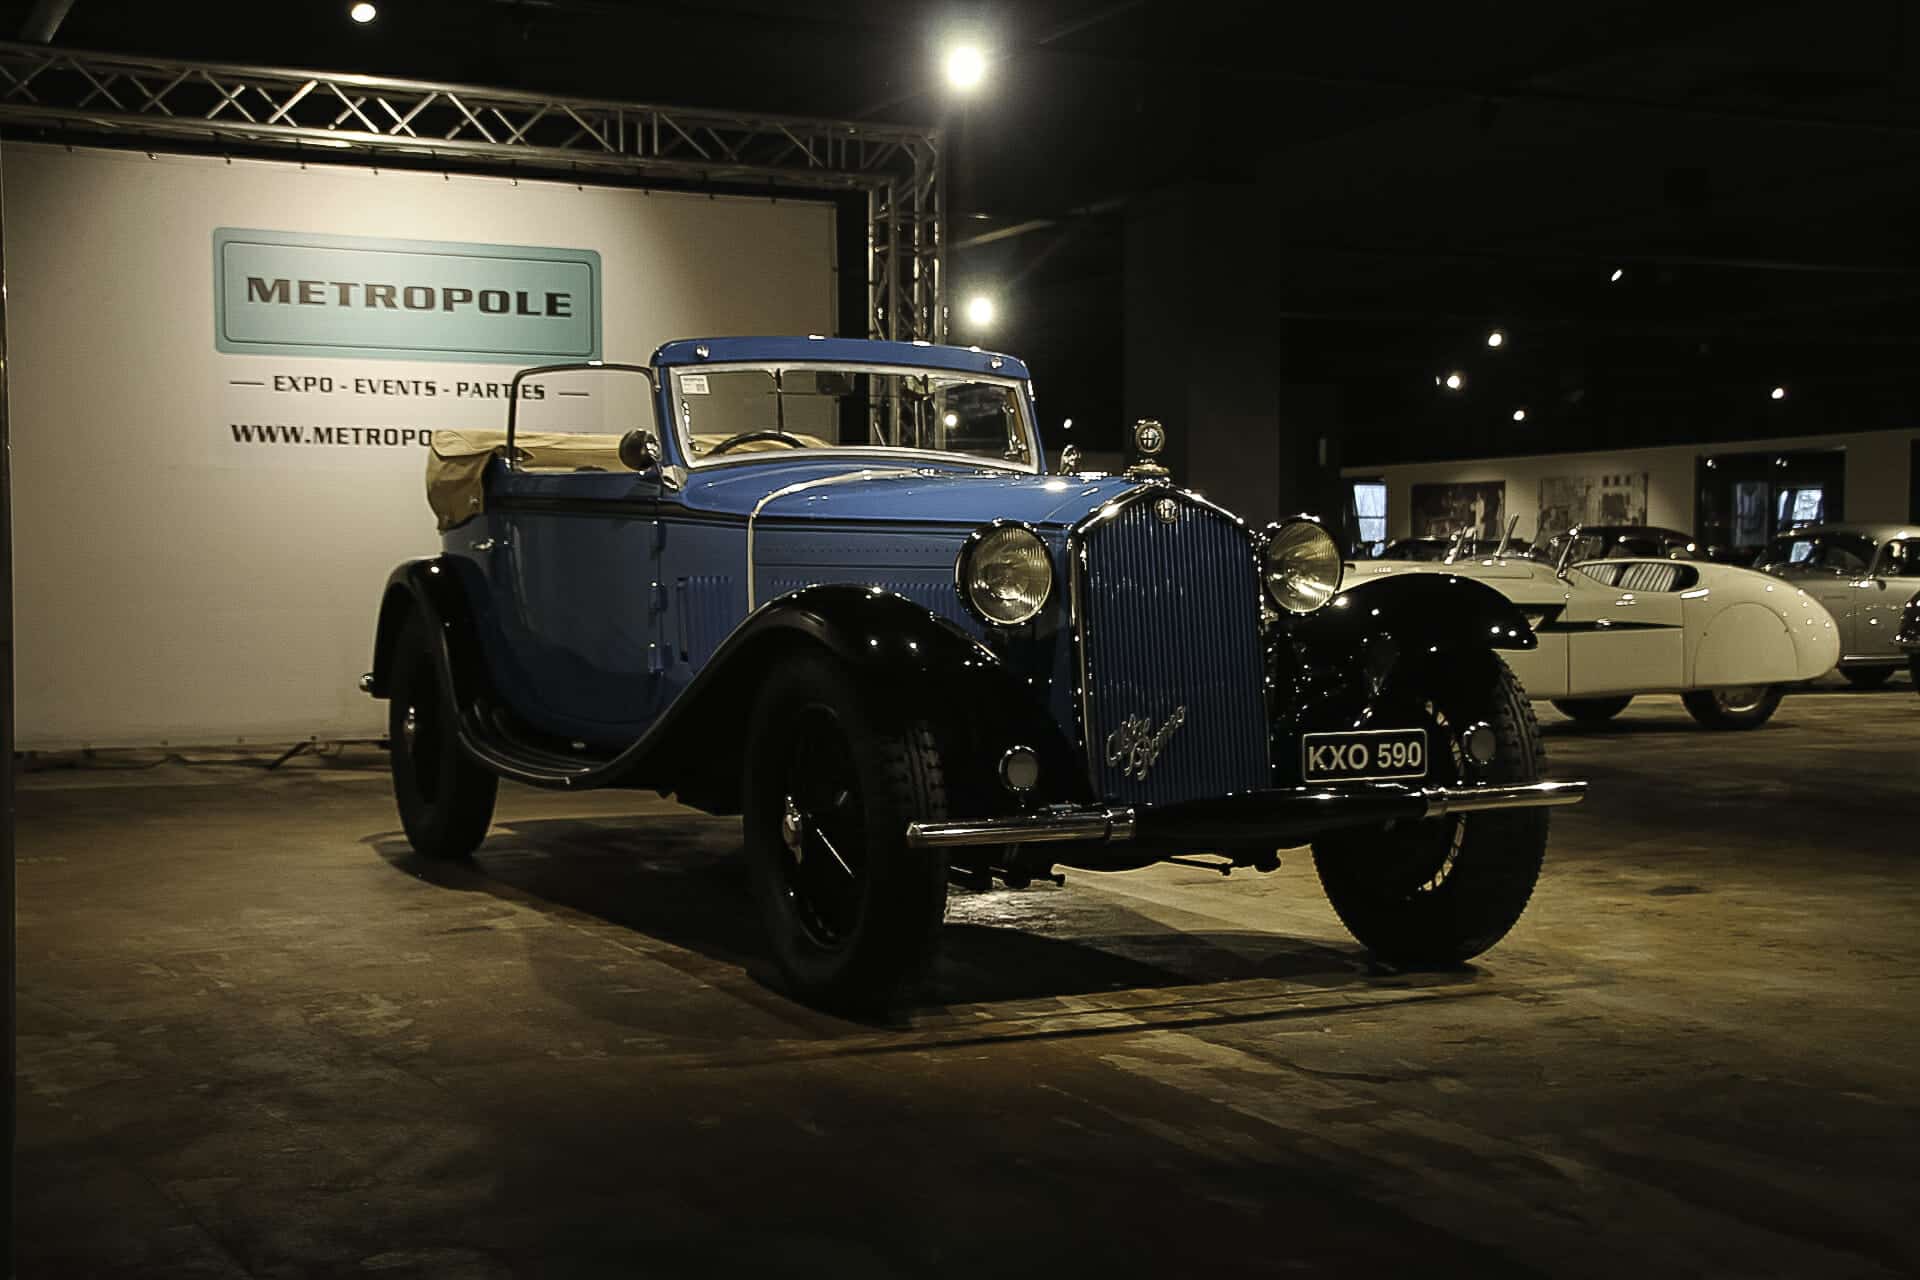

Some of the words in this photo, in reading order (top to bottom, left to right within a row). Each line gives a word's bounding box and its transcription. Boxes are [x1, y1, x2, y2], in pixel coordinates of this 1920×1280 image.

[247, 276, 573, 318] METROPOLE
[273, 375, 333, 393] EXPO
[354, 378, 436, 397] EVENTS
[456, 382, 545, 400] PARTES
[1308, 743, 1369, 771] KXO
[1377, 741, 1422, 768] 590
